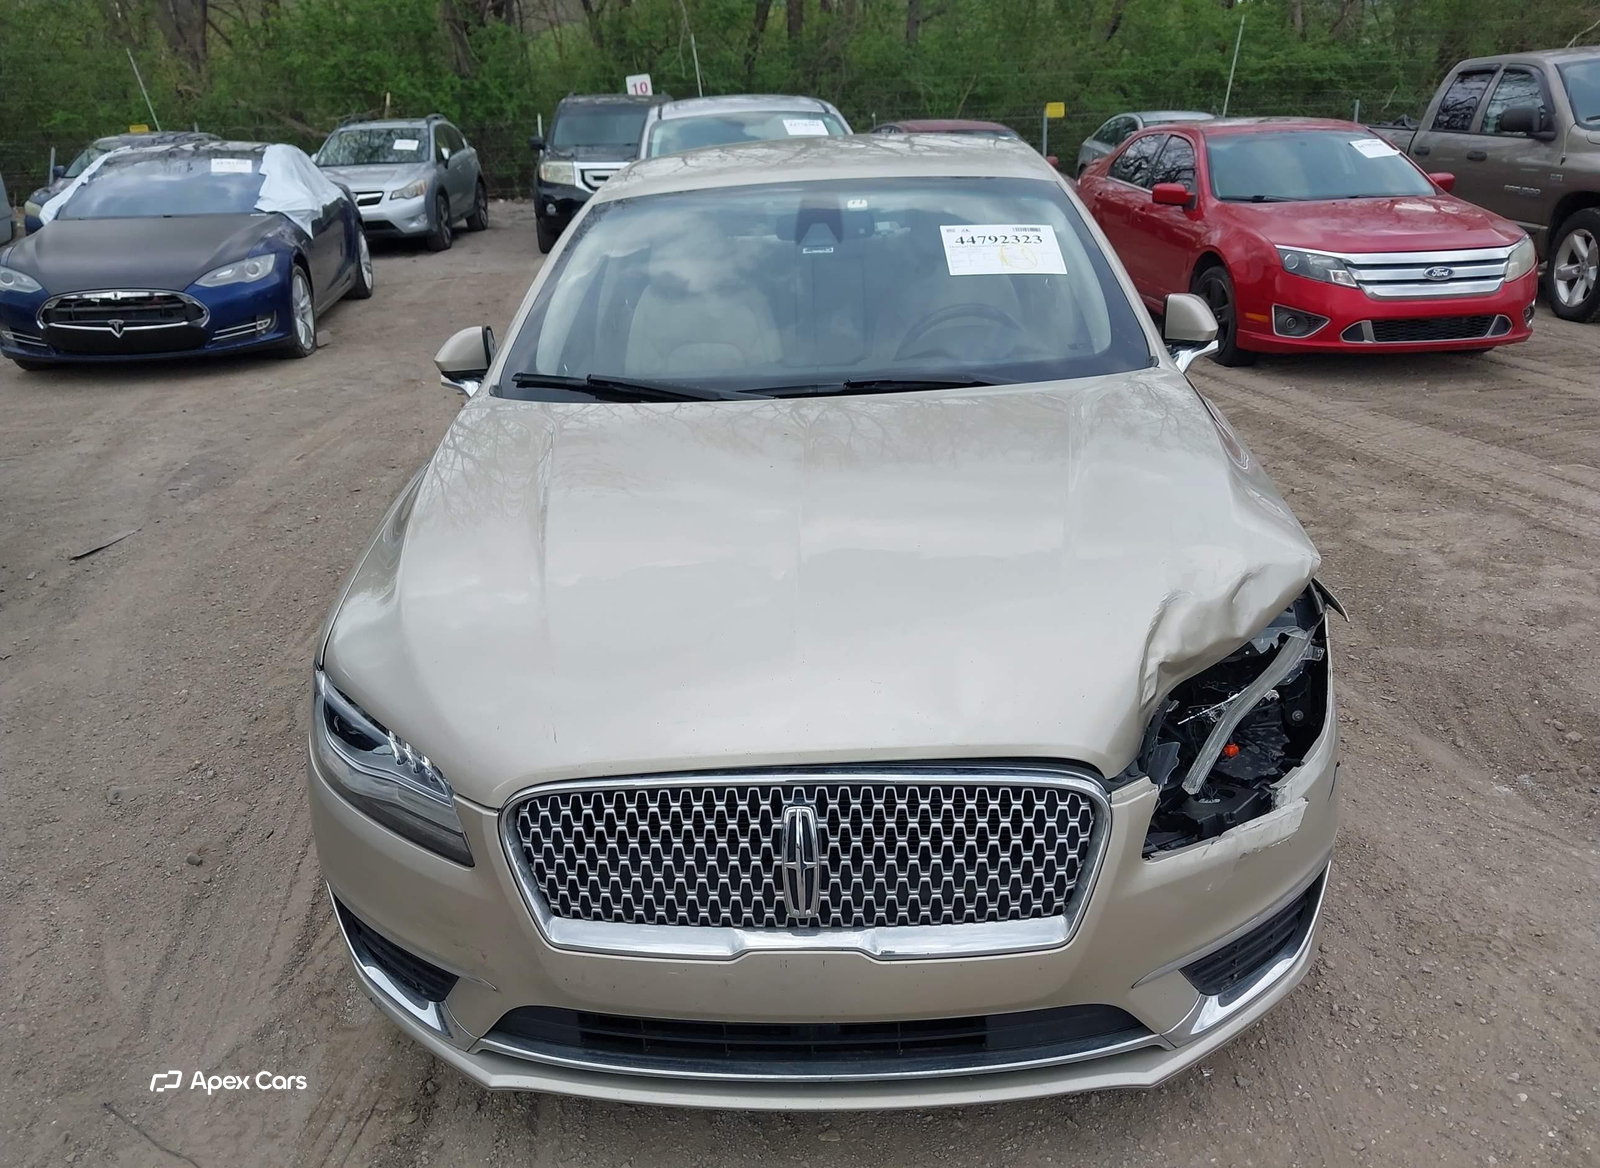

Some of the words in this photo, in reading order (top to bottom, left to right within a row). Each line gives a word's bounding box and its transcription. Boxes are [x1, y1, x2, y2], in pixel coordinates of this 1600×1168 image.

[632, 81, 648, 96] 10
[955, 234, 1043, 245] 44792323
[1431, 268, 1450, 277] Ford
